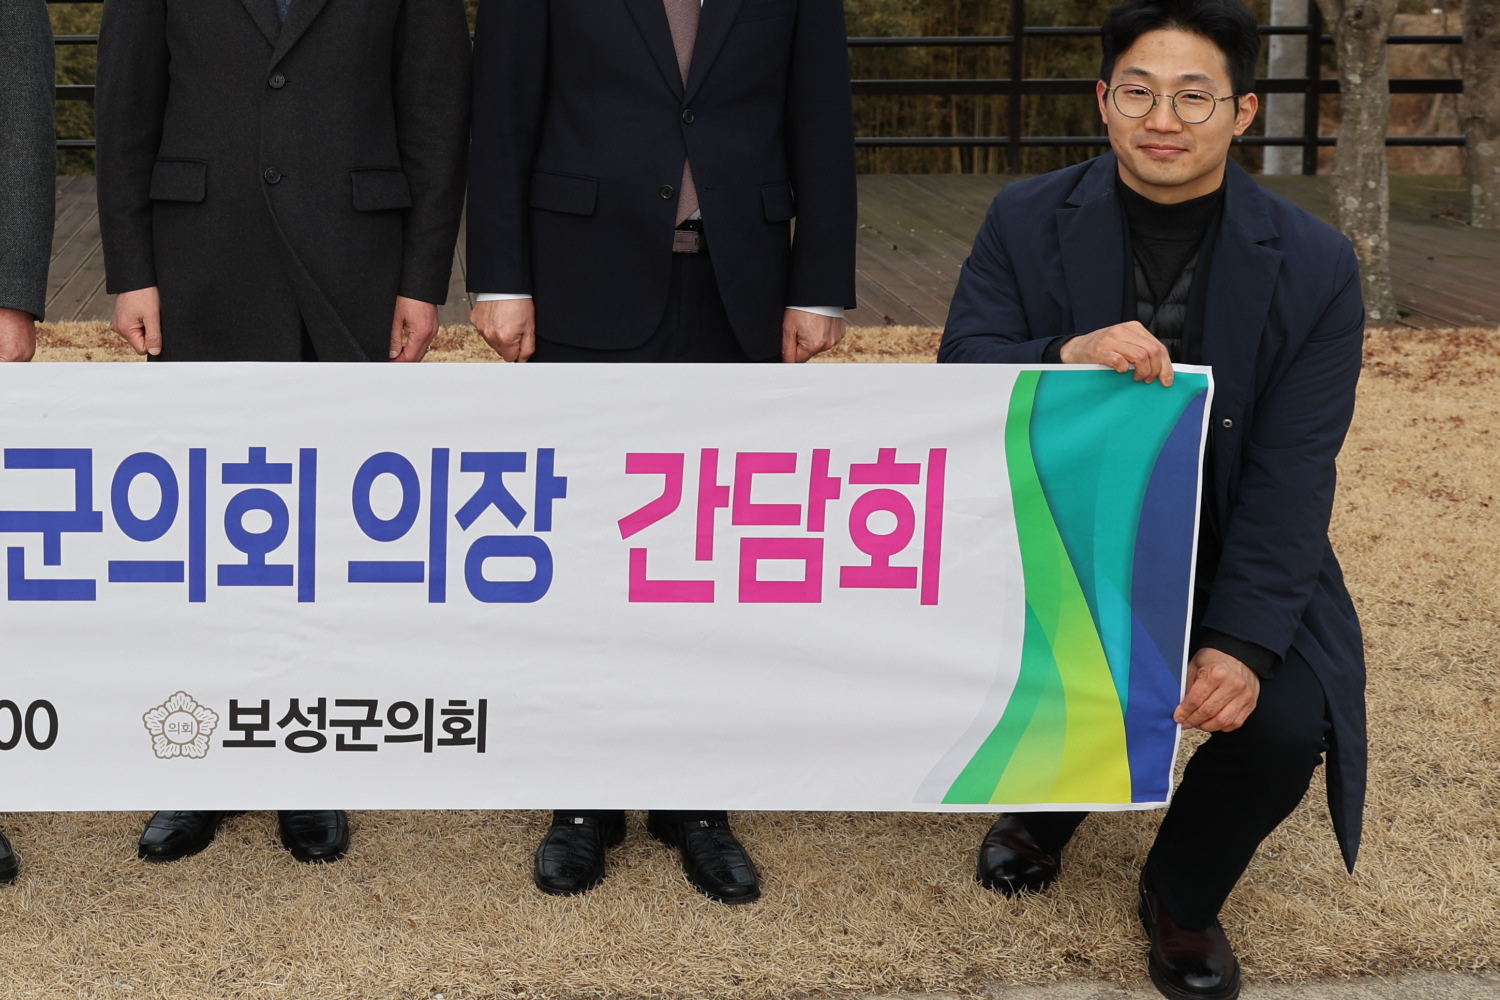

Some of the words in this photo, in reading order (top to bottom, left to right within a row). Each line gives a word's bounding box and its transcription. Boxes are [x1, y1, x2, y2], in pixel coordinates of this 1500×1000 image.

[347, 447, 568, 604] 의장
[617, 447, 948, 606] 간담회
[168, 721, 193, 735] 의회
[222, 697, 488, 754] 보성군의회
